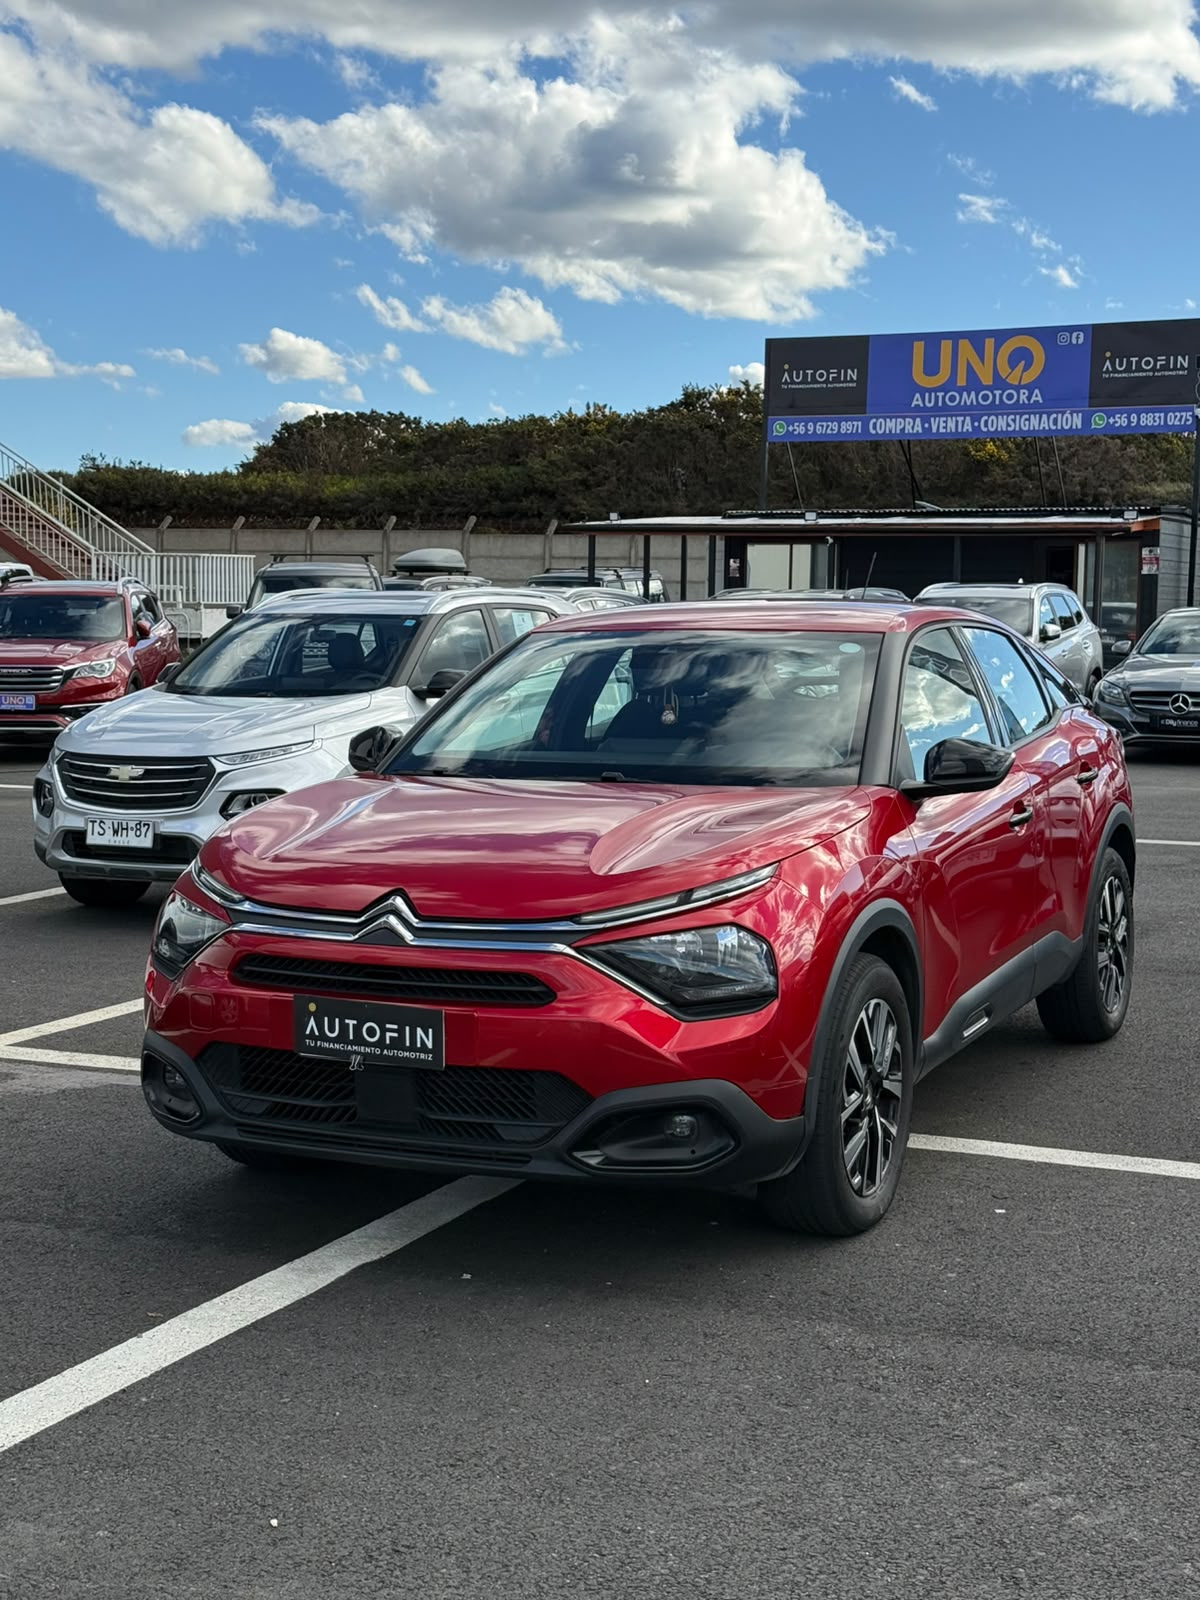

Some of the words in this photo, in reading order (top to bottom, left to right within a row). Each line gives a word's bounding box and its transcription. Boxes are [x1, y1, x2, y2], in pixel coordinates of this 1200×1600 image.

[912, 335, 1045, 388] UNO
[1102, 353, 1189, 372] AUTOFIN
[781, 366, 857, 383] AUTOFIN
[911, 388, 1043, 408] AUTOMOTORA
[788, 422, 806, 435] +56
[807, 421, 814, 435] 9
[815, 421, 838, 435] 6729
[840, 420, 862, 434] 8971
[869, 416, 923, 434] COMPRA
[930, 416, 973, 433] VENTA
[980, 410, 1083, 432] CONSIGNACIÓN
[1107, 413, 1128, 427] +56
[1130, 413, 1137, 427] 9
[1139, 412, 1164, 426] 8831
[1167, 411, 1193, 425] 0275
[305, 1012, 433, 1049] AUTOFIN
[305, 1039, 316, 1047] TU
[317, 1040, 381, 1055] FINANCIAMIENTO
[383, 1048, 433, 1061] AUTOMOTRIZ
